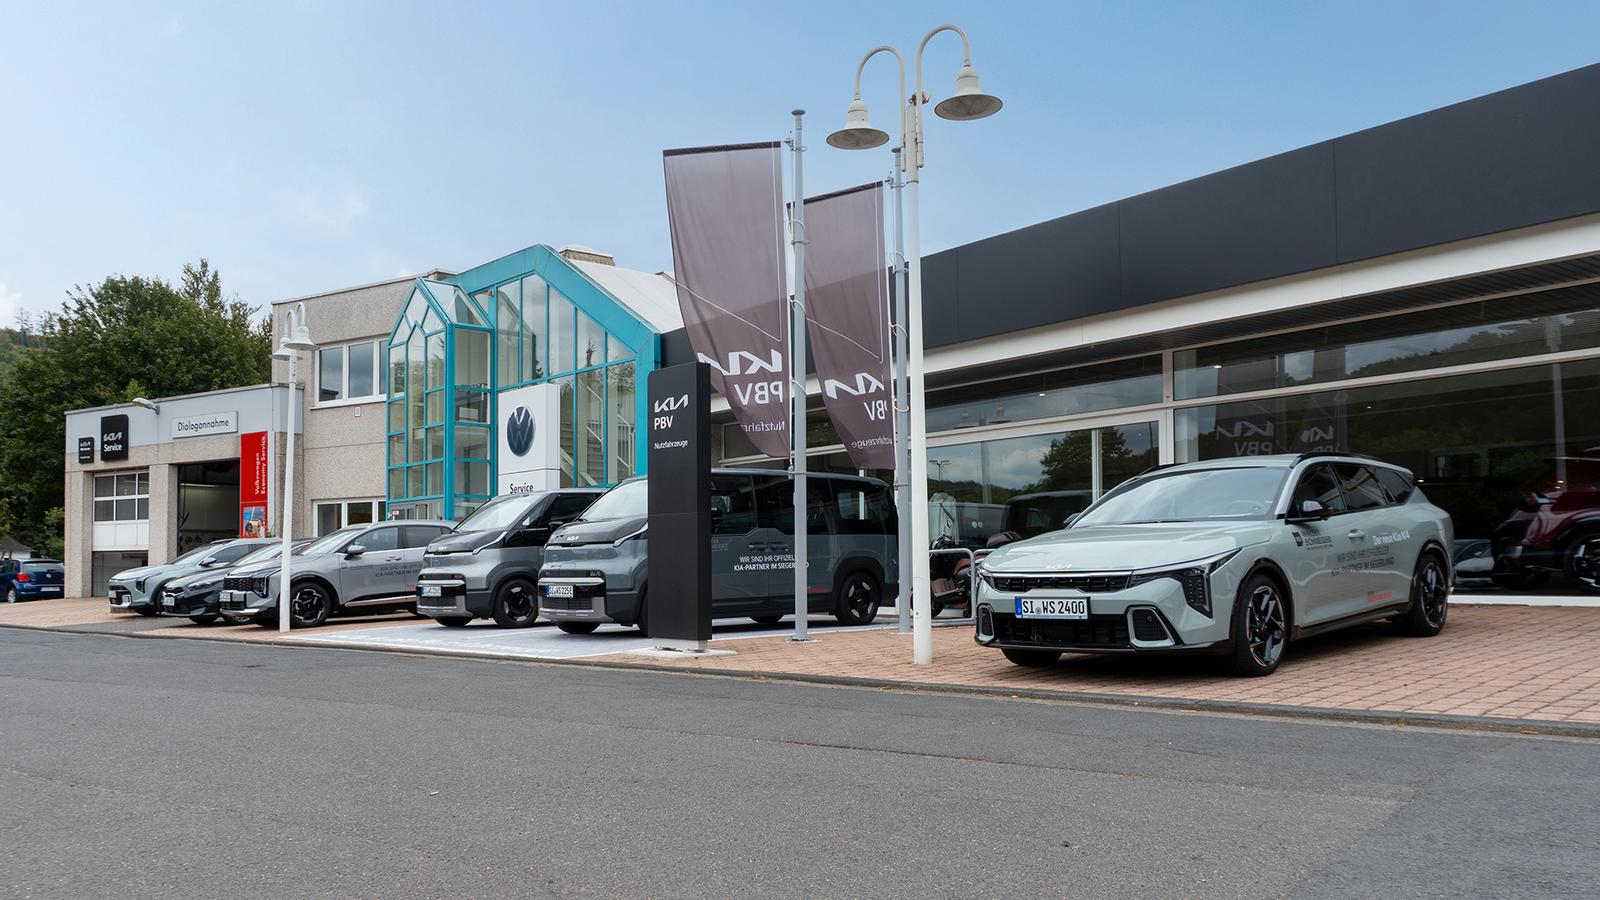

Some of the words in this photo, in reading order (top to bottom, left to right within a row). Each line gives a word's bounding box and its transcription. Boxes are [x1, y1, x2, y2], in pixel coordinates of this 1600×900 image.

[654, 394, 689, 413] KIA
[178, 418, 229, 432] Dialogannahme
[654, 415, 674, 430] PBV
[103, 443, 123, 452] Service
[654, 439, 689, 450] Nutzfahrzeuge
[509, 482, 534, 494] Service
[734, 563, 770, 571] KIA-PARTNER
[770, 562, 777, 570] IM
[1022, 600, 1034, 613] SI
[1041, 600, 1056, 614] WS
[1058, 600, 1085, 614] 2400
